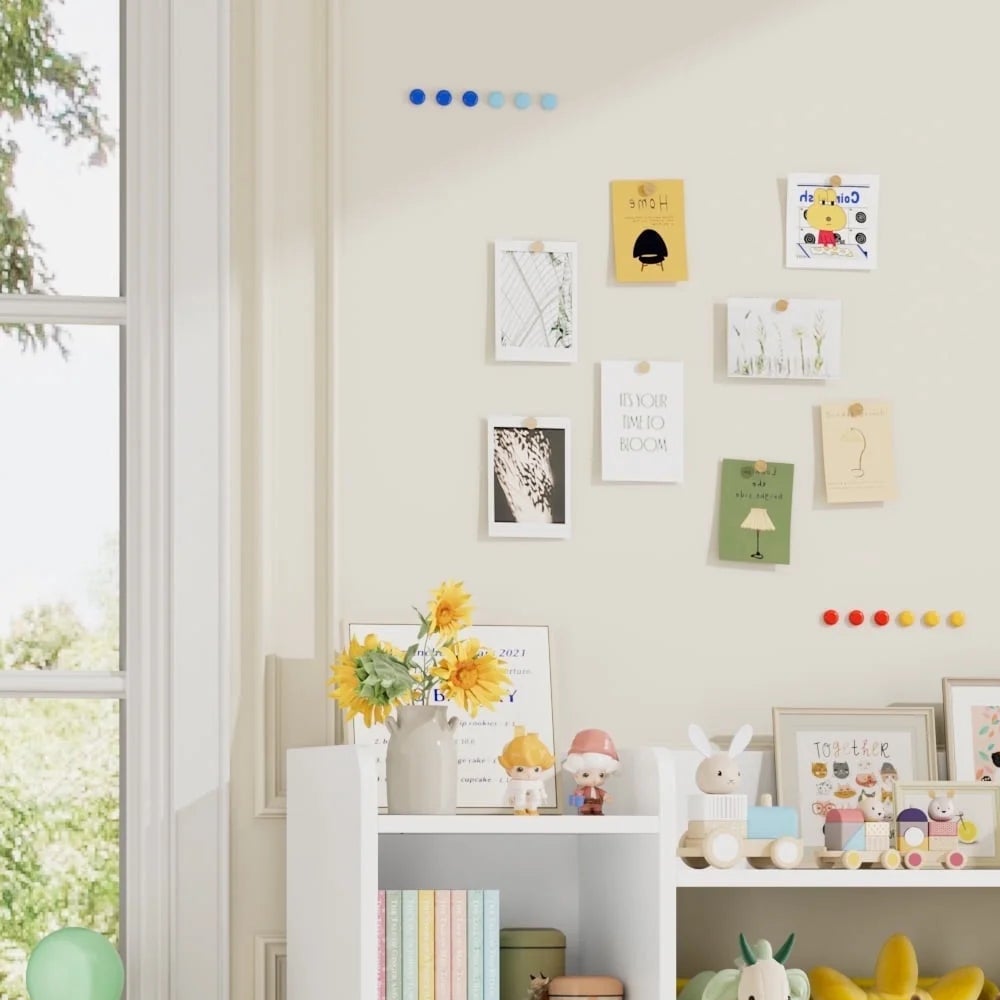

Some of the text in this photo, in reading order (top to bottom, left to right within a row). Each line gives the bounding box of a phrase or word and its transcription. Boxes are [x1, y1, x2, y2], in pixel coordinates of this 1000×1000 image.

[635, 392, 667, 408] YOUR
[646, 414, 665, 430] TO
[619, 436, 667, 452] BLOOM
[499, 648, 527, 657] 2021
[461, 776, 492, 785] cupcake
